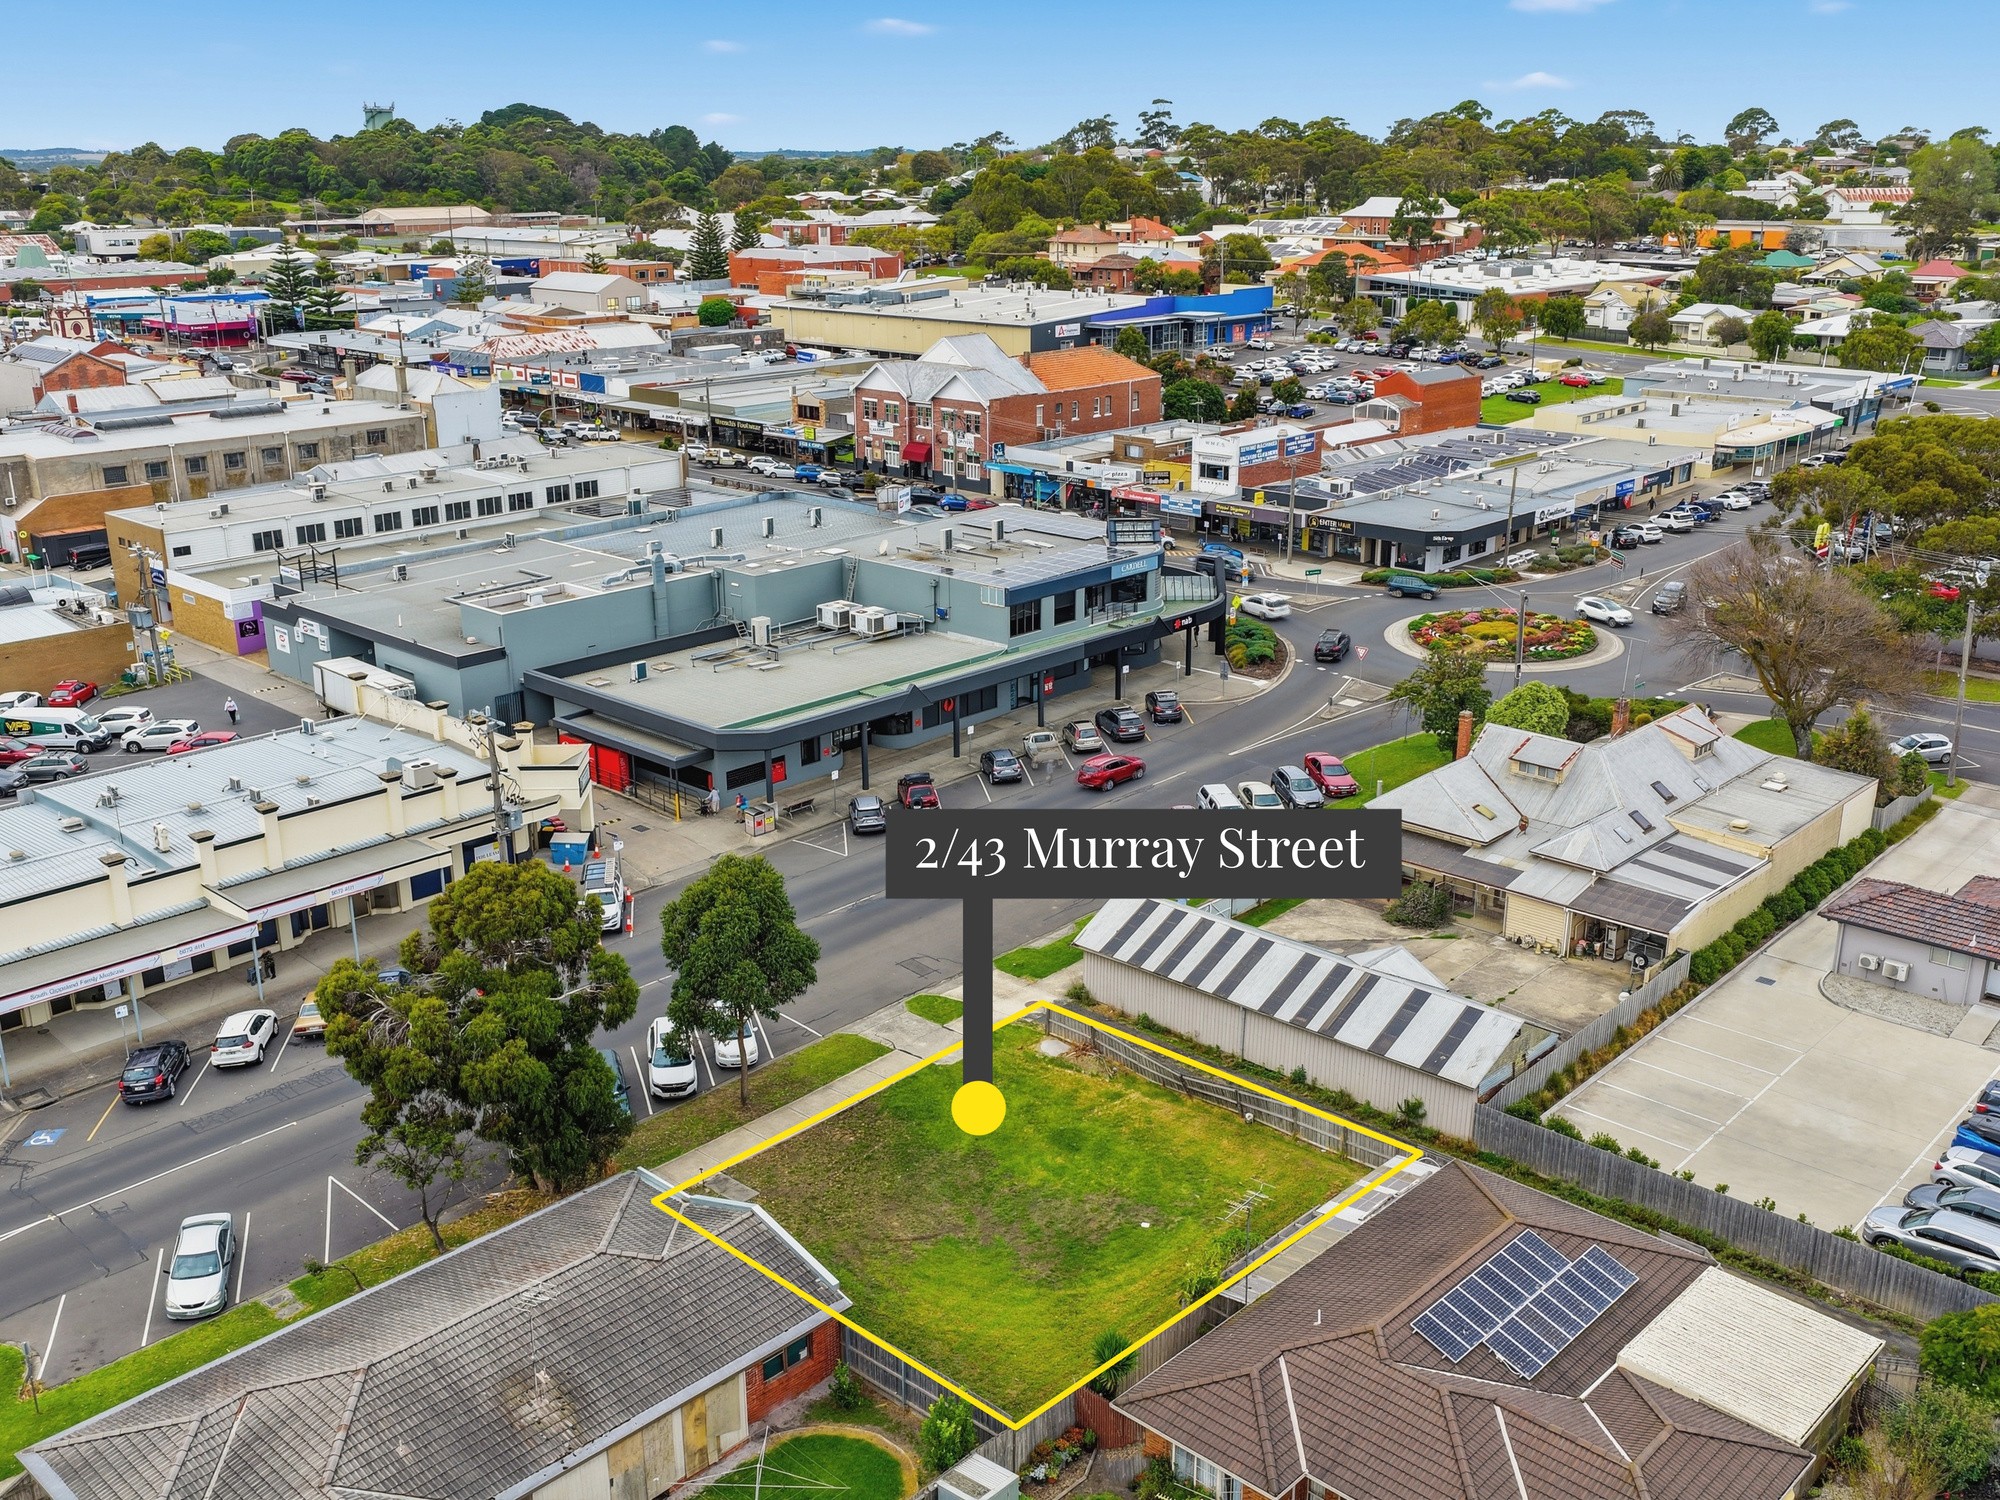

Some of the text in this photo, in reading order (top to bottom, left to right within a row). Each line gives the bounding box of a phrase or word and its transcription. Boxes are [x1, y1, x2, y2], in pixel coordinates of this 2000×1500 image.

[1181, 616, 1193, 626] nab
[5, 721, 31, 731] VPS
[30, 968, 125, 1001] South Gippsland Family Medicine
